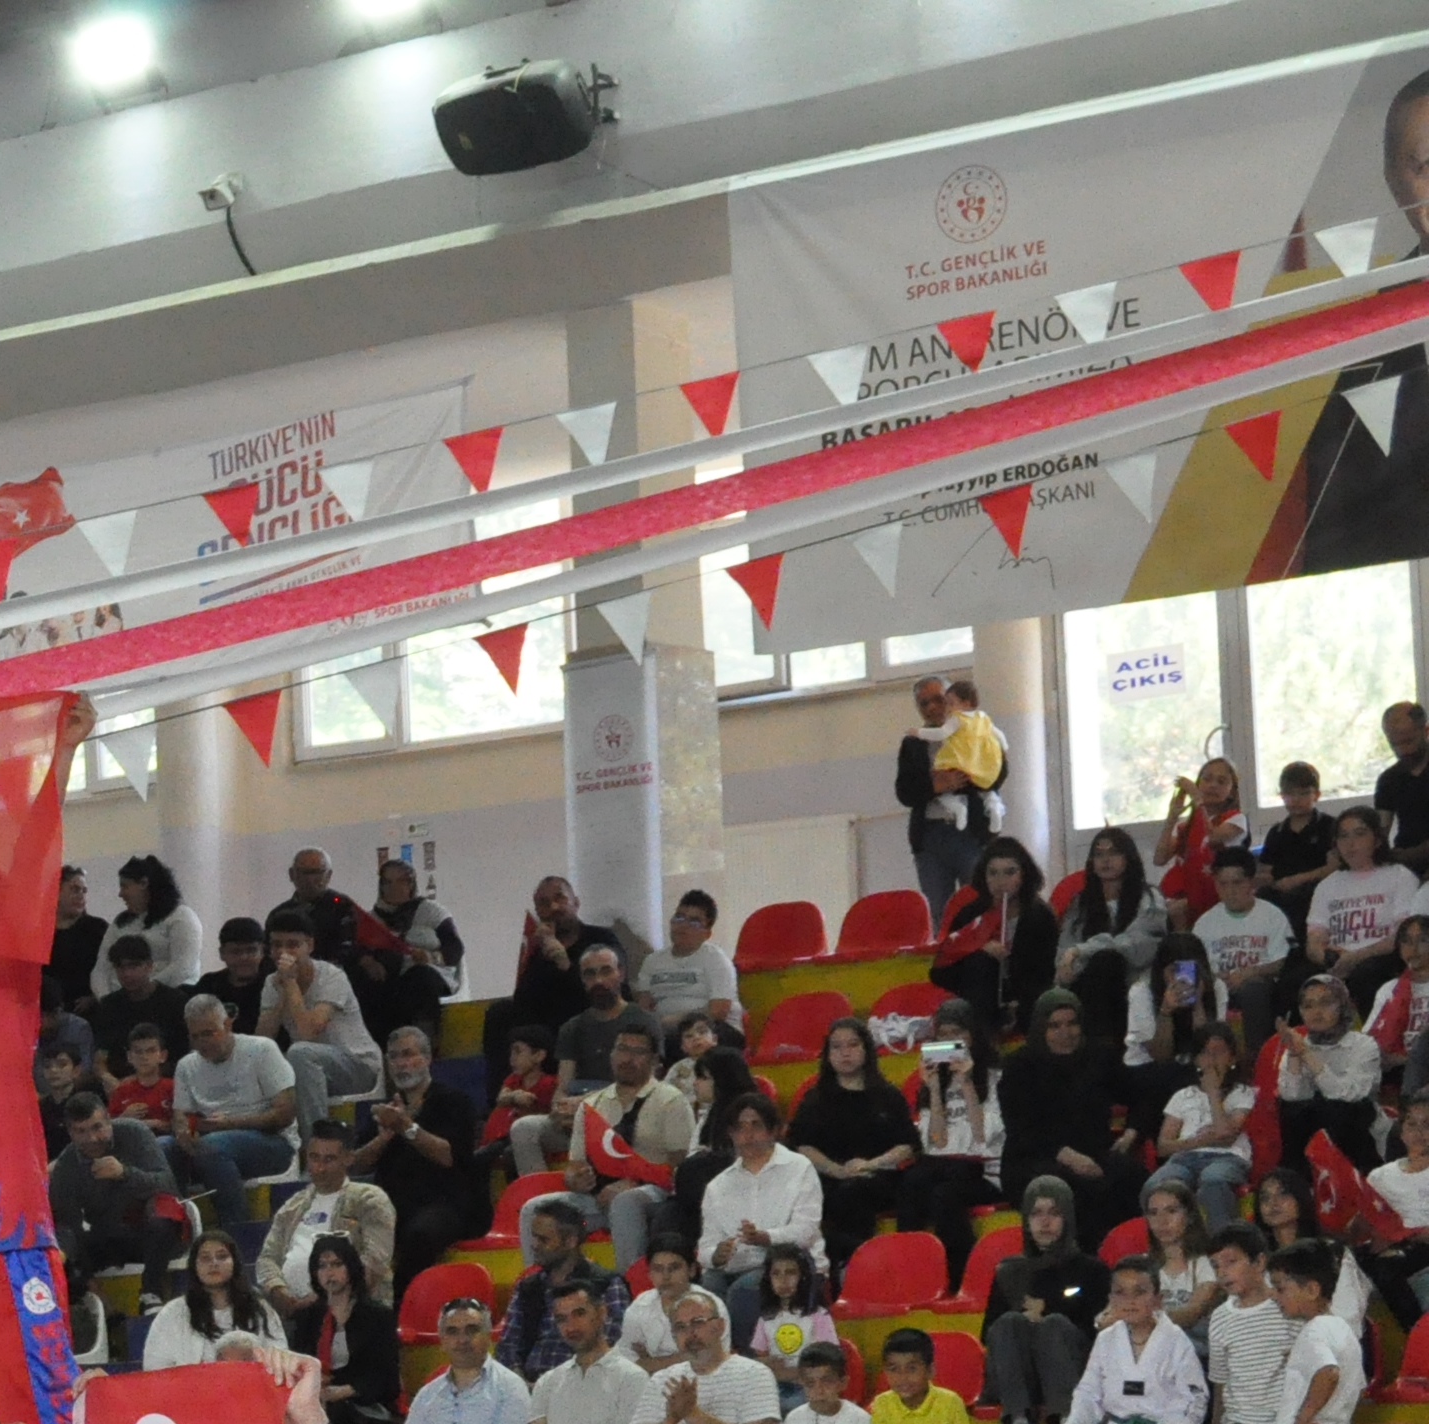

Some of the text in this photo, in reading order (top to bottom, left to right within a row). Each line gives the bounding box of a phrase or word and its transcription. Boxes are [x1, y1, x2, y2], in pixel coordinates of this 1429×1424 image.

[905, 240, 1047, 279] T.C. GENÇLİK VE
[906, 259, 1049, 301] SPOR BAKANLIĞI
[208, 410, 336, 480] TÜRKİYE'NİN
[228, 449, 325, 517] ÜCÜ
[1002, 452, 1099, 483] ERDOĞAN
[374, 603, 404, 620] SPOR
[1116, 653, 1178, 674] ACİL
[1112, 671, 1183, 692] ÇIKIŞ
